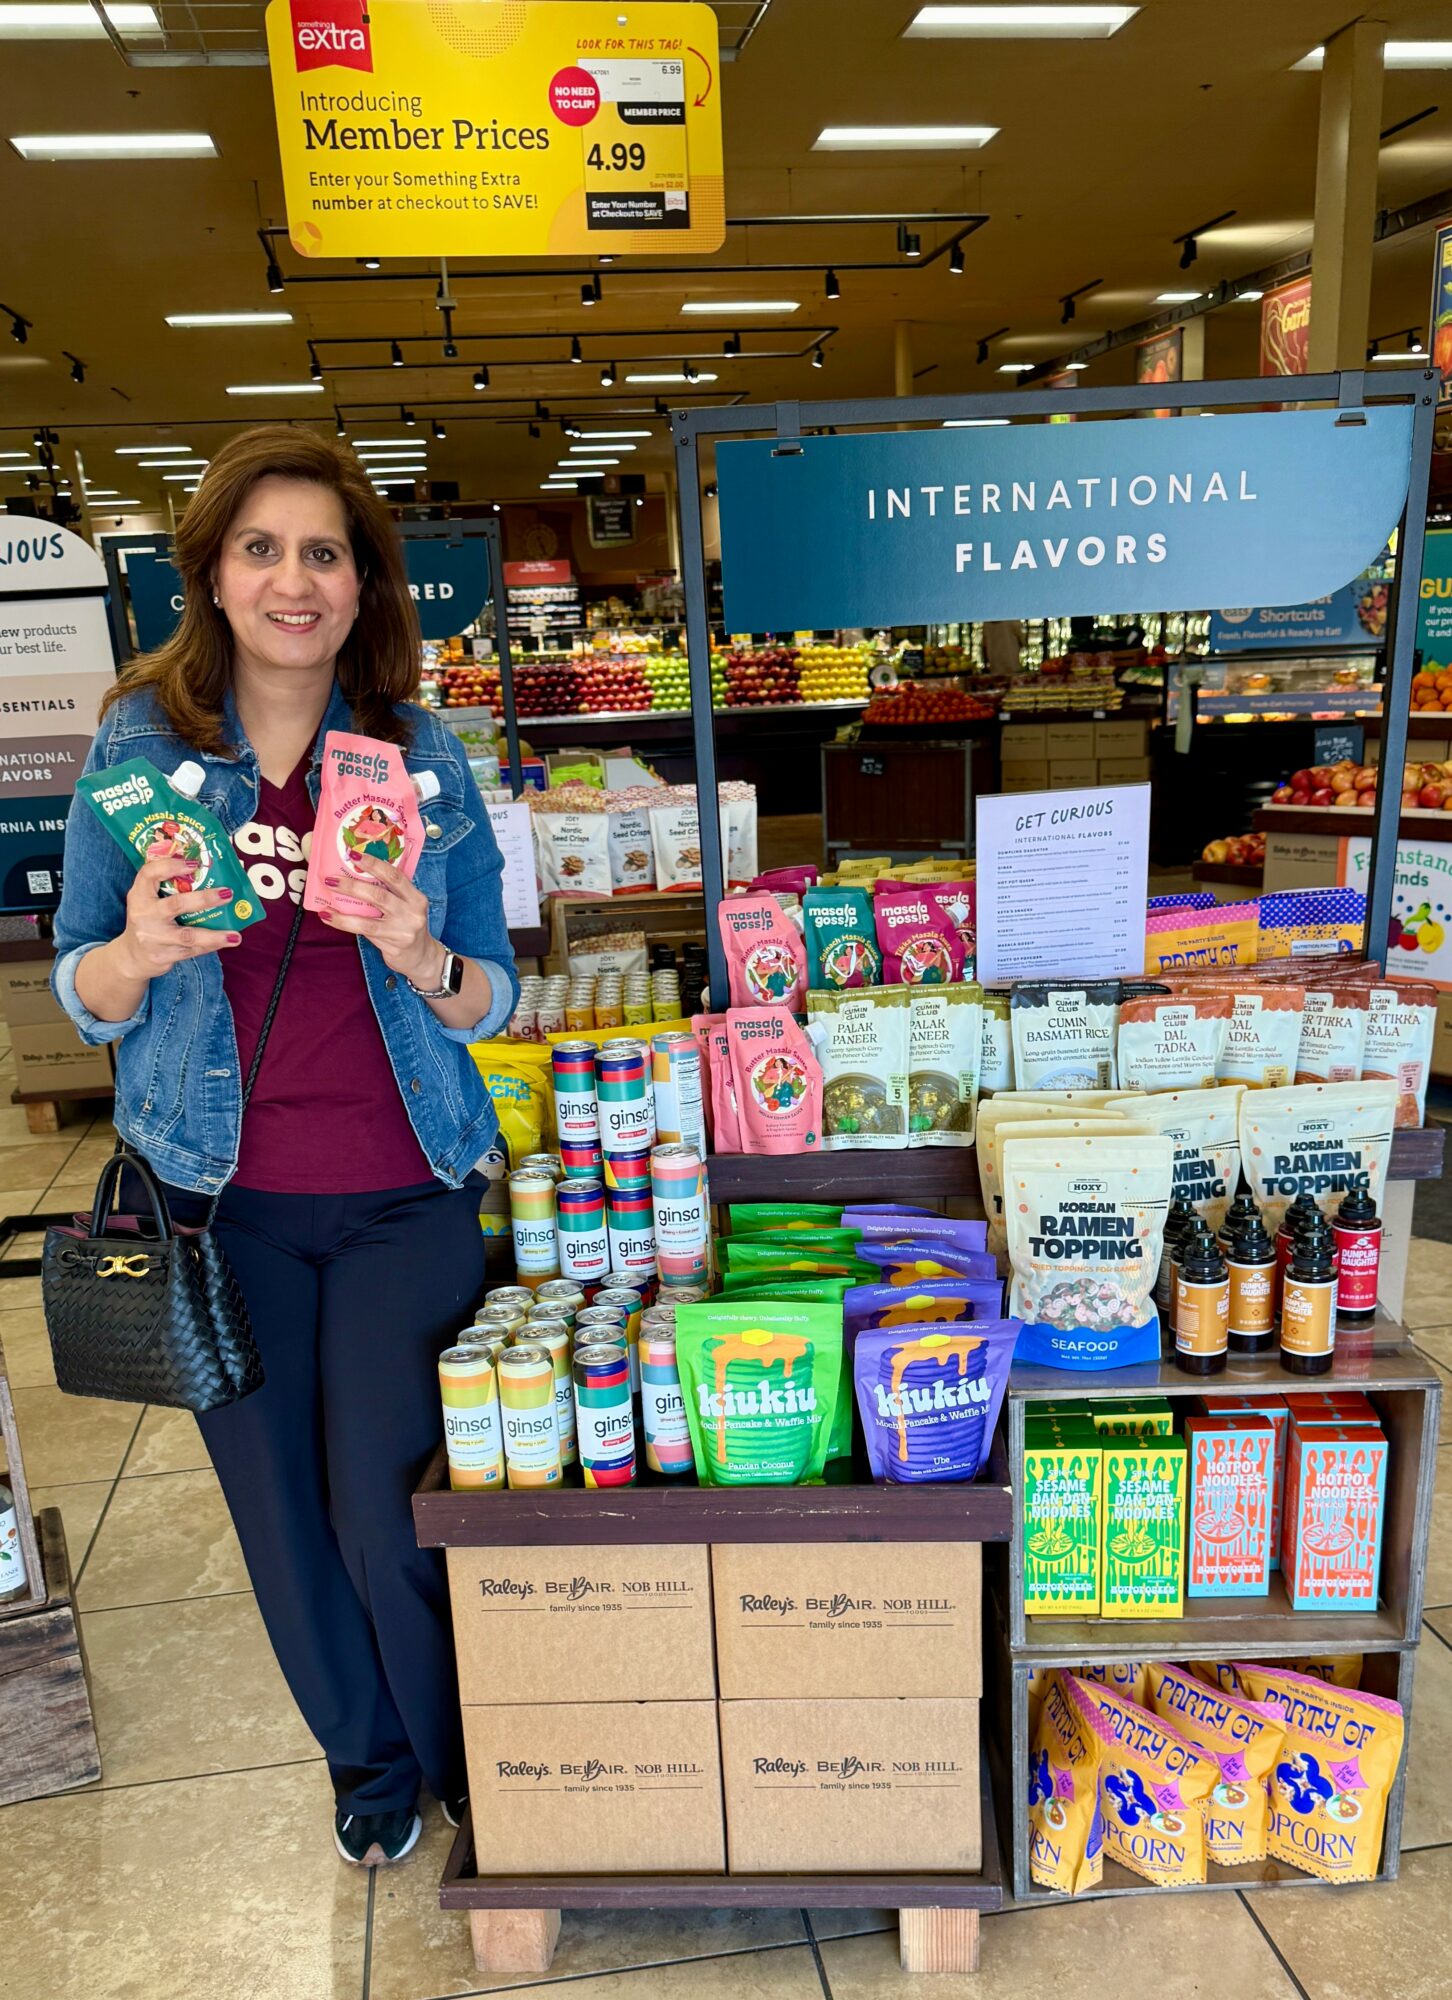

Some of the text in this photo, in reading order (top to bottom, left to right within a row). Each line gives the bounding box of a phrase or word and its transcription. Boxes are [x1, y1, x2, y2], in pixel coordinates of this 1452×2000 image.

[297, 21, 331, 29] something
[298, 23, 366, 51] extra
[576, 38, 683, 50] LOOK FOR THIS TAG!
[661, 65, 681, 75] 6.99
[554, 86, 595, 96] NO NEED
[301, 90, 422, 117] Introducing
[556, 99, 595, 109] TO CLIP!
[624, 108, 681, 116] MEMBER PRICE
[304, 119, 550, 151] Member Prices
[587, 142, 646, 171] 4.99
[309, 170, 521, 191] Enter your Something Extra
[312, 194, 539, 210] number at checkout to SAVE!
[611, 201, 628, 209] Your
[600, 209, 635, 218] Checkout
[635, 210, 643, 218] to
[867, 469, 1258, 520] INTERNATIONAL
[955, 532, 1169, 573] FLAVORS
[1258, 609, 1326, 624] Shortcuts
[23, 624, 77, 639] products
[15, 641, 67, 654] best life.
[331, 749, 389, 771] masala
[337, 761, 389, 785] gossip
[92, 773, 150, 804] masala
[102, 784, 154, 816] gossip
[334, 793, 395, 820] Butter Masala
[1015, 800, 1114, 832] GET CURIOUS
[552, 834, 590, 844] Seed Crisps
[1014, 830, 1113, 844] INTERNATIONAL FLAVORS
[726, 908, 772, 921] masala
[808, 904, 857, 918] masala
[881, 901, 928, 917] masala
[732, 918, 774, 933] gossip
[814, 915, 858, 929] gossip
[887, 914, 931, 928] gossip
[734, 1017, 783, 1030] masala
[1048, 1017, 1087, 1028] CUMIN
[1315, 1014, 1353, 1028] TIKKA
[1382, 1013, 1421, 1025] TIKKA
[740, 1028, 785, 1041] gossip
[837, 1022, 873, 1033] PALAK
[832, 1033, 878, 1045] PANEER
[1026, 1028, 1110, 1042] BASMATI RICE
[1164, 1030, 1187, 1041] DAL
[1154, 1042, 1197, 1053] TADKA
[745, 1047, 792, 1073] Butter Masala
[609, 1107, 648, 1130] ginsa
[1303, 1123, 1329, 1131] HOXY
[1290, 1139, 1343, 1152] KOREAN
[1274, 1152, 1362, 1175] RAMEN
[1059, 1202, 1116, 1213] KOREAN
[658, 1205, 700, 1227] ginsa
[1040, 1216, 1134, 1237] RAMEN
[516, 1226, 555, 1247] ginsa
[566, 1237, 606, 1259] ginsa
[1029, 1237, 1143, 1260] TOPPING
[1342, 1248, 1378, 1258] DUMPLING
[1053, 1264, 1142, 1273] TOPPINGS FOR RAMEN
[1341, 1256, 1377, 1267] DAUGHTER
[1051, 1338, 1118, 1352] SEAFOOD
[697, 1380, 817, 1417] kiukiu
[874, 1377, 991, 1418] kiukiu
[725, 1418, 804, 1429] Pancake & Waffle
[904, 1408, 980, 1428] Pancake & Waffle
[446, 1416, 492, 1436] ginsa
[507, 1416, 553, 1438] ginsa
[728, 1461, 794, 1470] Pandan Coconut
[933, 1456, 950, 1466] Ube
[1207, 1461, 1259, 1474] HOTPOT
[1036, 1480, 1087, 1492] SESAME
[1119, 1481, 1170, 1492] SESAME
[1202, 1474, 1263, 1487] NOODLES
[1316, 1473, 1370, 1486] HOTPOT
[1032, 1493, 1091, 1505] DAN DAN
[1311, 1486, 1374, 1499] NOODLES
[1115, 1494, 1174, 1506] DAN DAN
[1032, 1506, 1091, 1518] NOODLES
[1114, 1507, 1175, 1519] NOODLES
[479, 1578, 534, 1600] Raley's
[622, 1582, 651, 1592] NOB
[549, 1603, 622, 1613] family since 1935
[740, 1594, 795, 1616] Raley's
[883, 1599, 912, 1610] NOB
[809, 1620, 883, 1629] family since 1935
[1156, 1675, 1265, 1744] PARTY OF
[1264, 1688, 1376, 1750] PARTY OF
[753, 1757, 807, 1778] Raley's
[892, 1762, 920, 1772] NOB
[1165, 1747, 1200, 1776] OF
[496, 1761, 550, 1781] Raley's
[634, 1764, 662, 1775] NOB
[1342, 1764, 1357, 1777] Pad
[1336, 1771, 1353, 1785] Thai
[564, 1784, 635, 1793] family since 1935
[820, 1782, 891, 1791] family since 1935
[1162, 1787, 1177, 1799] Pad
[1157, 1793, 1175, 1806] Thai
